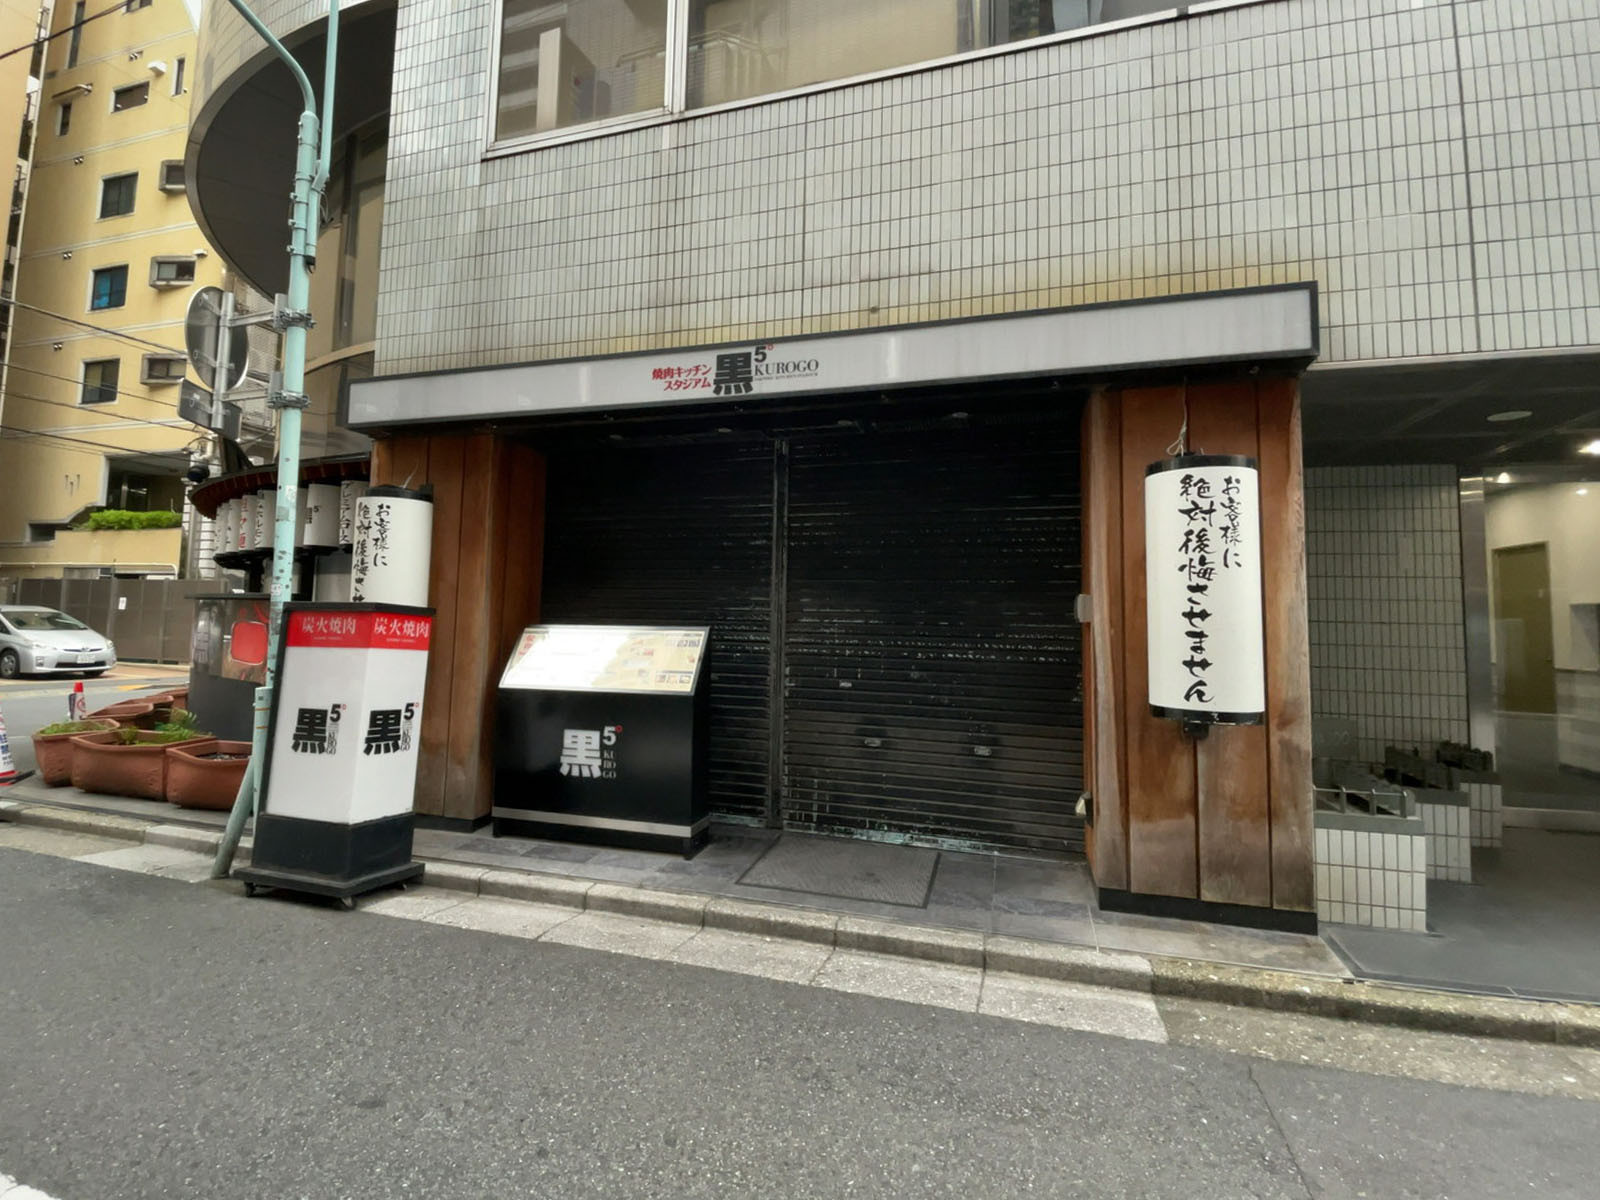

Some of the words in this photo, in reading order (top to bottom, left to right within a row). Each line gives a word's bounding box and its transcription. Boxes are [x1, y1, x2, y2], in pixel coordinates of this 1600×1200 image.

[664, 377, 712, 392] スタジアム
[713, 352, 753, 395] 黒
[755, 359, 819, 376] KUROGO
[372, 503, 392, 568] お客様に
[1219, 475, 1243, 568] お客様に
[1178, 473, 1217, 703] 絶対後悔させません
[291, 708, 328, 755] 黒
[363, 709, 402, 756] 黒
[560, 728, 602, 778] 黒
